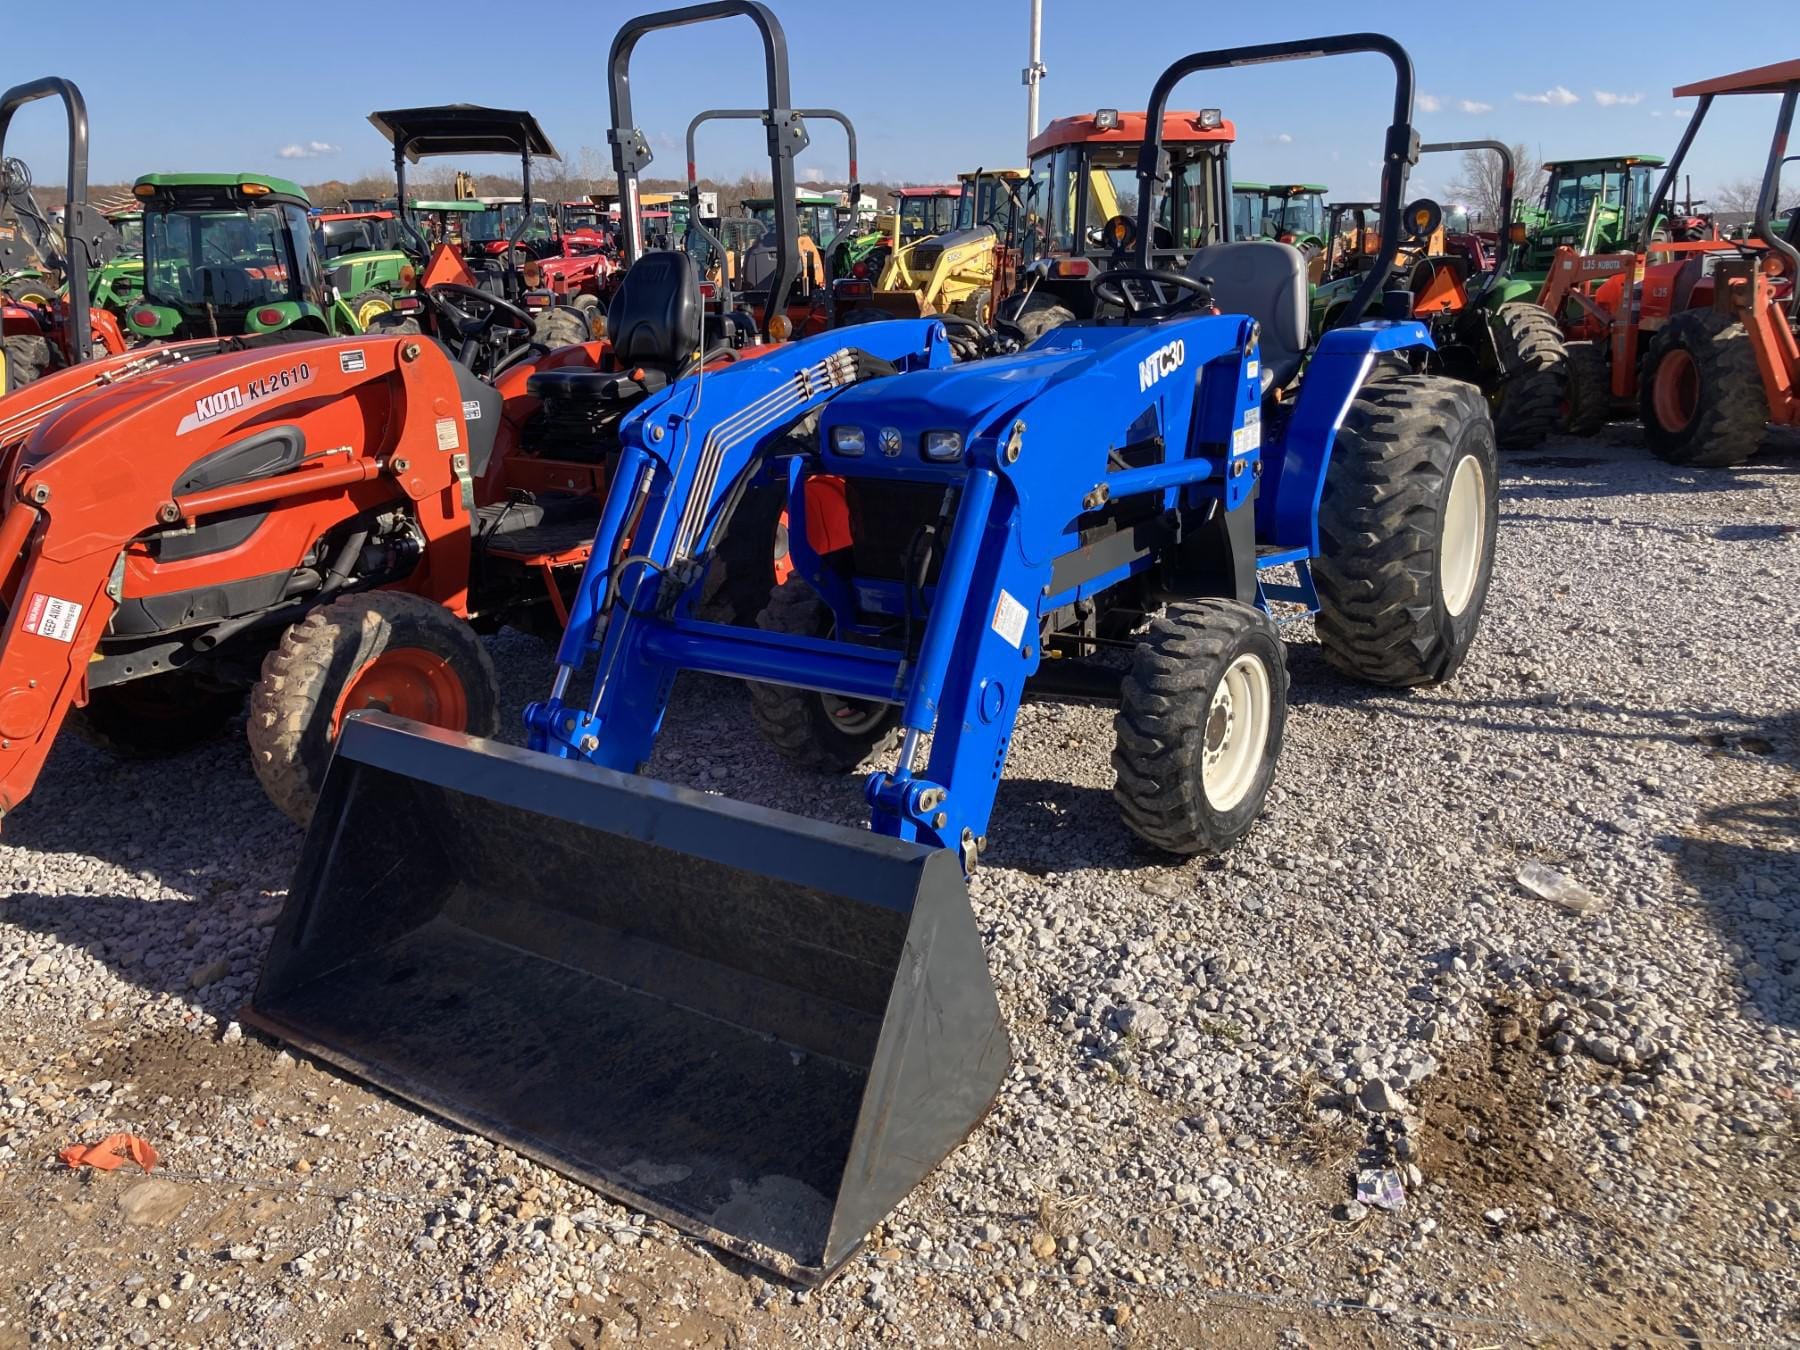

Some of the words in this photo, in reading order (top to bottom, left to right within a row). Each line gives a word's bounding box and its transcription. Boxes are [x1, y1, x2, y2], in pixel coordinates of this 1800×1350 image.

[195, 385, 243, 421] KIOTI
[249, 363, 309, 400] KL2610
[29, 595, 45, 620] WARNING
[48, 599, 64, 619] AWAY
[43, 619, 57, 636] KEEP
